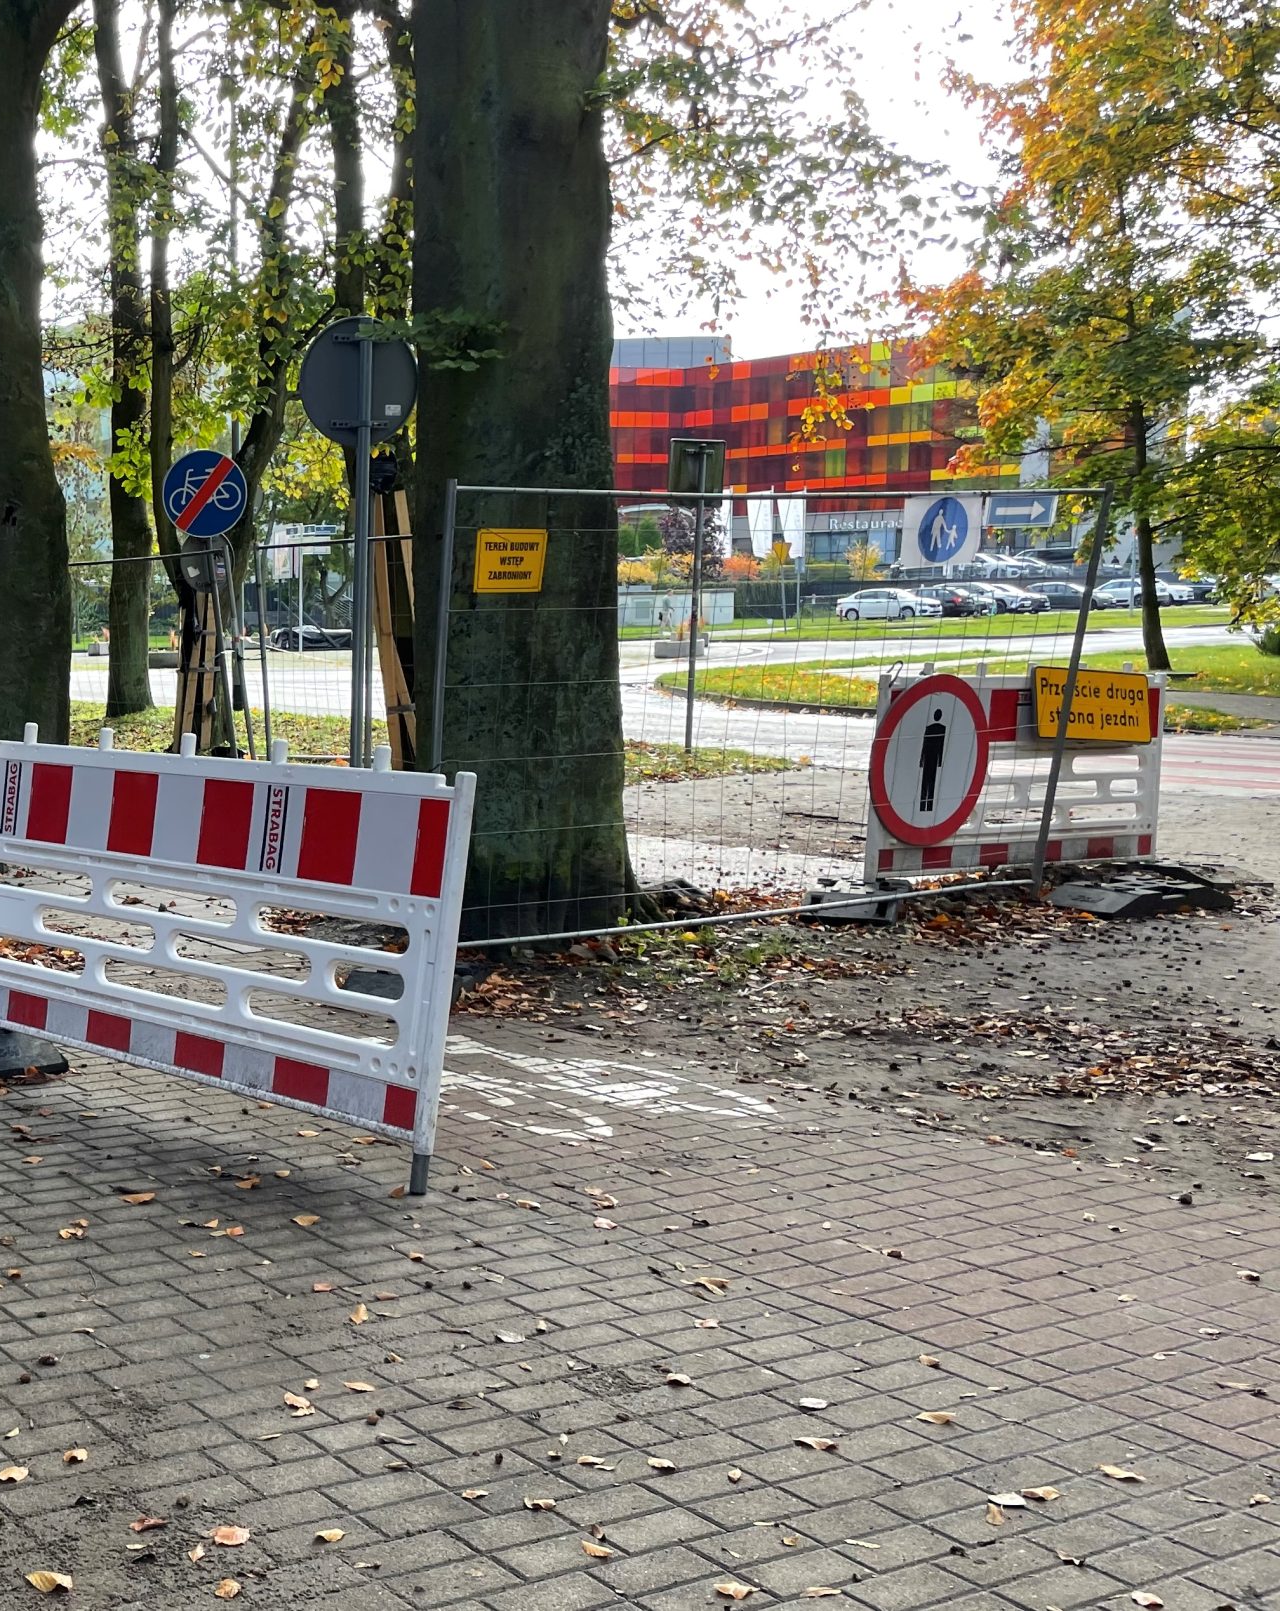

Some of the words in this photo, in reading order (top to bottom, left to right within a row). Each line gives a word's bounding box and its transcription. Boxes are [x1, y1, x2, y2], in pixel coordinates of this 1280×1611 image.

[485, 541, 508, 552] TEREN
[509, 541, 540, 552] BUDOWY
[499, 556, 525, 568] WSTĘP
[487, 570, 532, 581] ZABRONIONY
[1040, 677, 1100, 698] Przeście
[1100, 708, 1139, 730] jezdni
[4, 763, 18, 833] STRABAG
[265, 788, 283, 870] STRABAG
